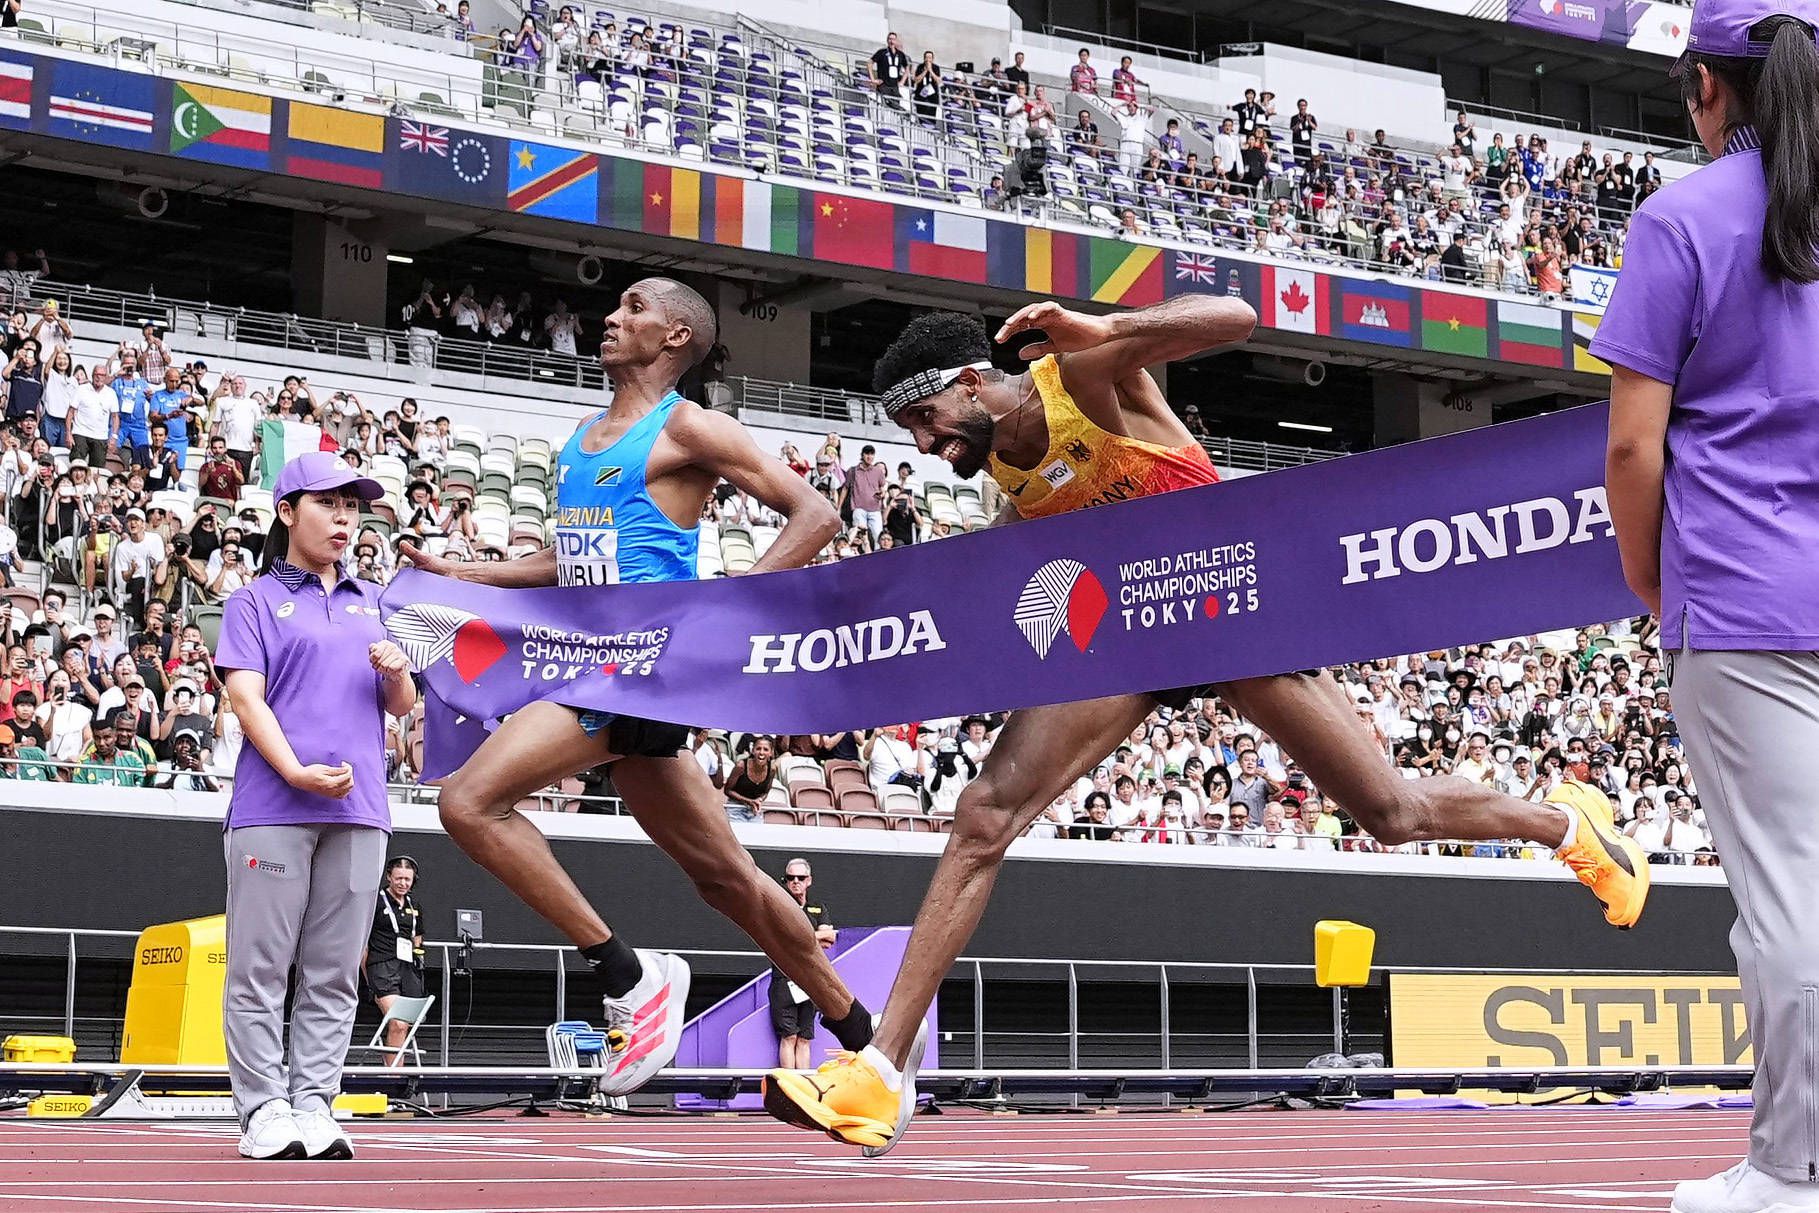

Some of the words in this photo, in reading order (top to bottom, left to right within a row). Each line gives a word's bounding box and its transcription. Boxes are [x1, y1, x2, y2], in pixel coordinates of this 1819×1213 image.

[340, 242, 372, 263] 110
[751, 305, 778, 322] 109
[1044, 462, 1068, 483] WGV
[556, 531, 607, 556] TDK
[1339, 486, 1617, 585] HONDA
[1119, 556, 1171, 582] WORLD
[1174, 541, 1256, 573] ATHLETICS
[1119, 564, 1257, 606] CHAMPIONSHIPS
[521, 624, 583, 644] WORLD
[742, 609, 947, 674] HONDA
[522, 641, 662, 665] CHAMPIONSHIPS
[141, 946, 183, 965] SEIKO
[44, 1102, 87, 1112] SEIKO
